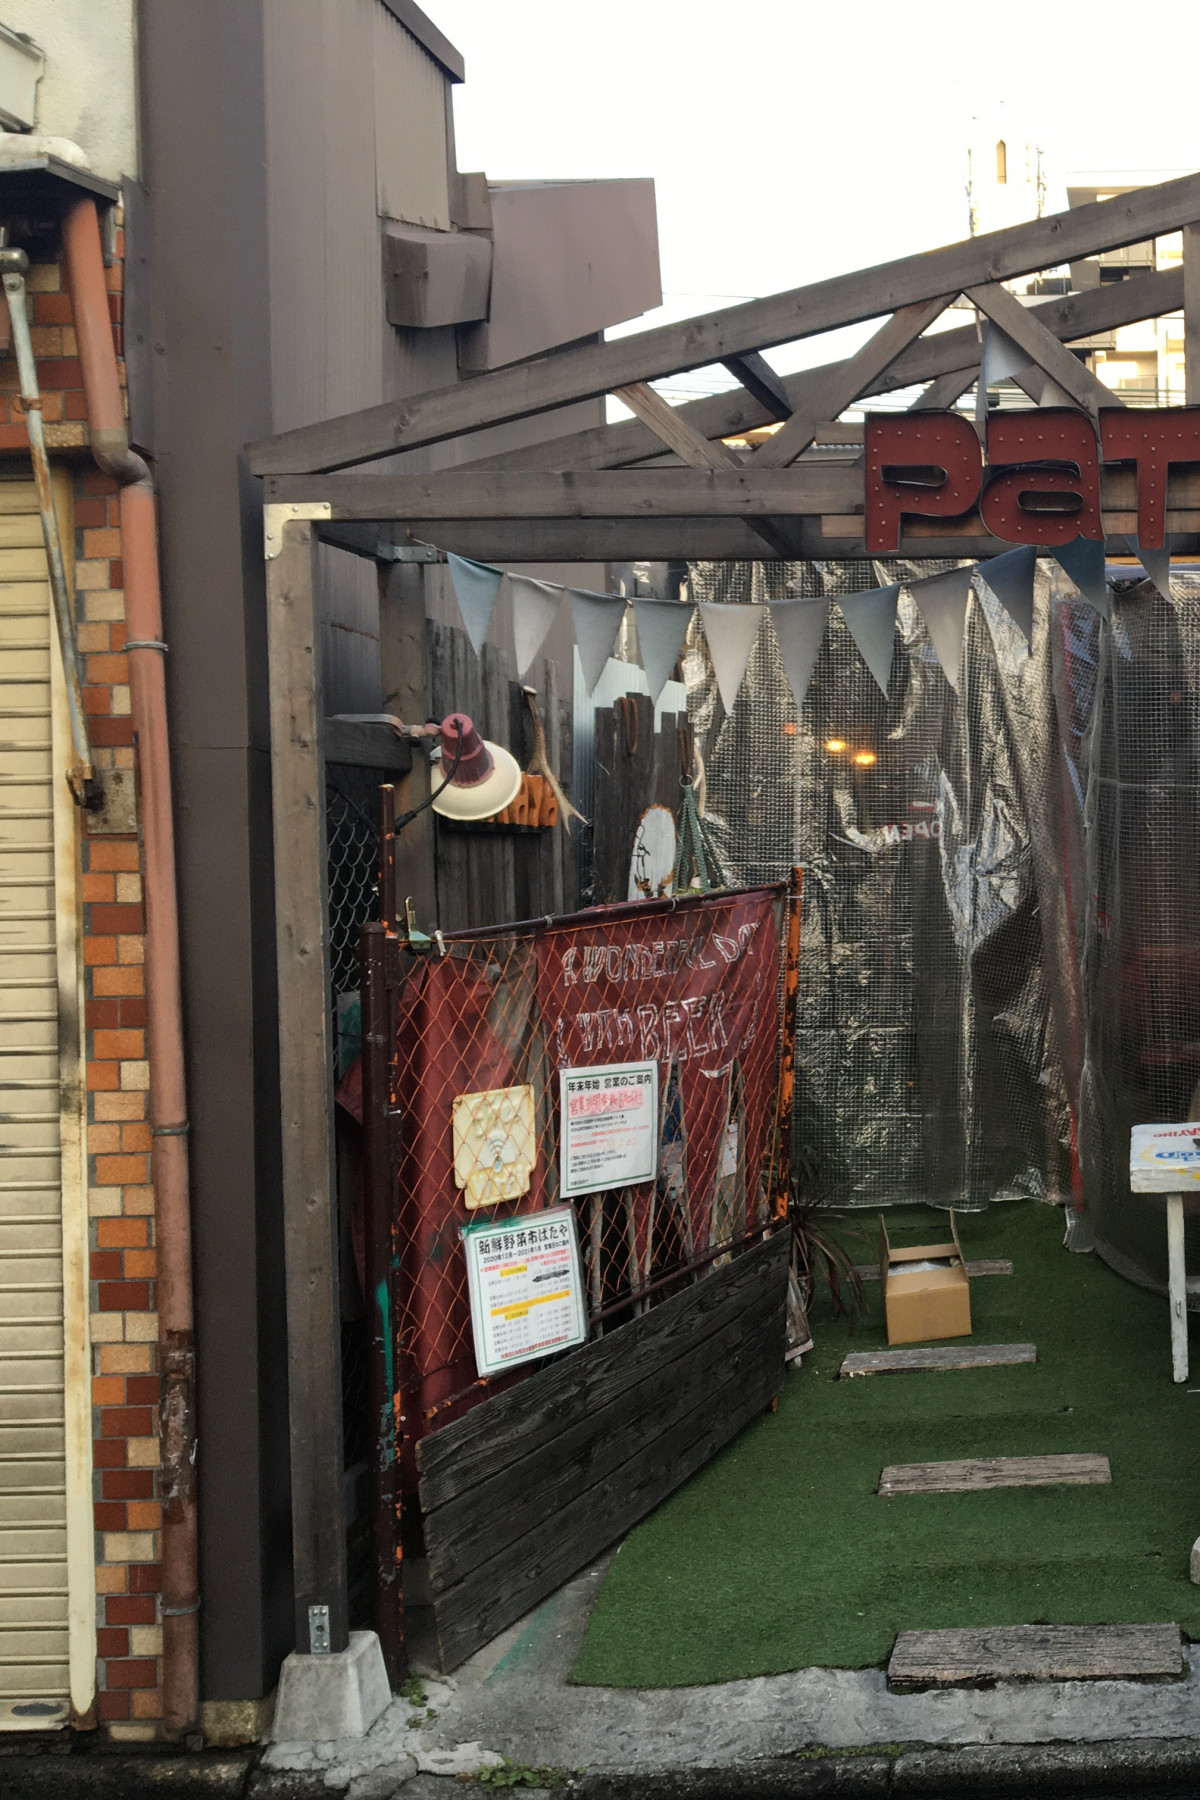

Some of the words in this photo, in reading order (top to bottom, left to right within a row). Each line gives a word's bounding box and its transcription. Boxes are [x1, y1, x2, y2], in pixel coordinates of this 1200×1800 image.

[568, 1079, 600, 1092] 年末年始
[604, 1074, 652, 1089] 営業のご案内
